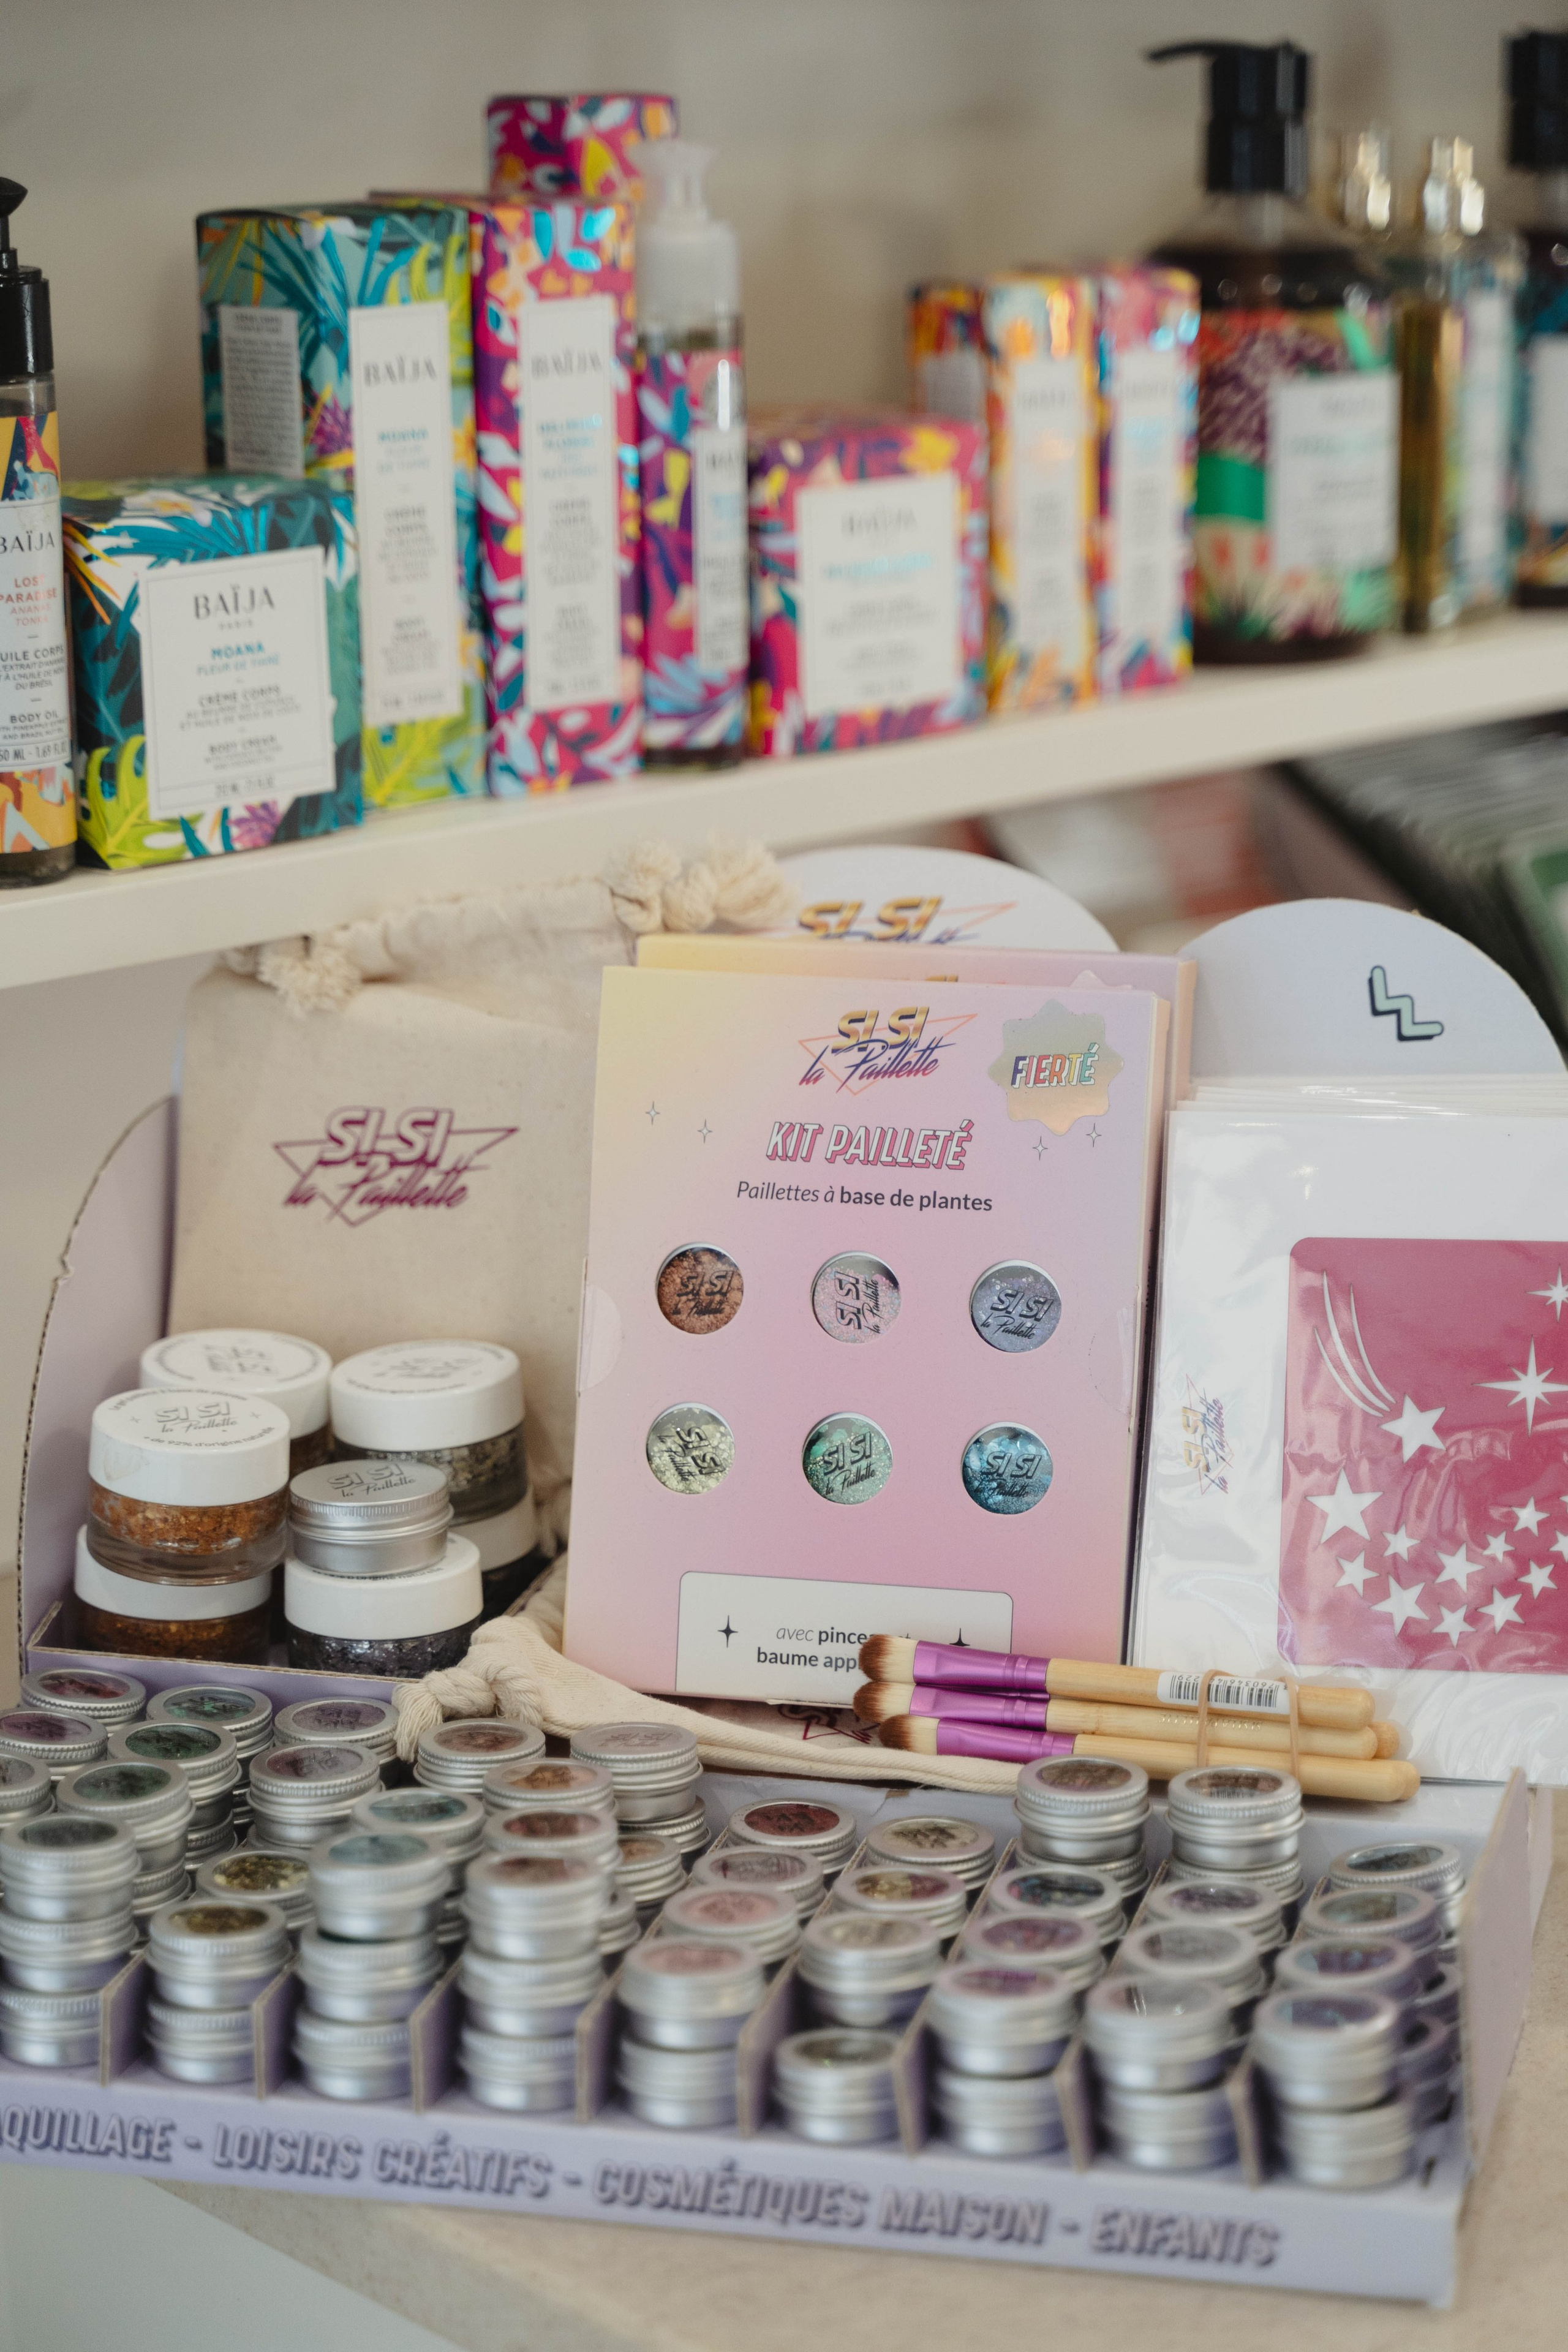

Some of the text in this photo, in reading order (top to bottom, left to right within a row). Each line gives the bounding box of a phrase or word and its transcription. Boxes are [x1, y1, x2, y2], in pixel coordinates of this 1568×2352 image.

[194, 583, 274, 620] BAÏJA
[34, 644, 64, 660] CORPS
[211, 641, 265, 660] MOANA
[0, 662, 37, 673] 'EXTRAIT
[15, 682, 28, 691] DU
[10, 709, 59, 725] BODY OIL
[13, 747, 26, 761] ML
[831, 1006, 930, 1054] SI SI
[799, 1035, 957, 1095] la Paillette
[1011, 1042, 1101, 1089] FIERTÉ
[766, 1118, 974, 1171] KIT PAILLETÉ
[737, 1181, 993, 1212] Paillettes à base de plantes
[705, 1269, 734, 1297] SI
[834, 1270, 862, 1330] SI SI
[861, 1276, 884, 1324] Paillette
[990, 1288, 1054, 1322] SI SI
[980, 1311, 1041, 1340] la Paillette
[155, 1401, 231, 1423] SI SI
[162, 1416, 239, 1434] la Paillette
[195, 1438, 242, 1447] d'origine
[1182, 1406, 1210, 1473] SI SI
[1200, 1387, 1234, 1471] Paillette
[675, 1426, 726, 1475] SI SI
[823, 1430, 872, 1476] SI SI
[981, 1450, 1042, 1479] SI SI
[327, 1463, 404, 1490] SI SI
[341, 1476, 417, 1498] la Paillette
[832, 1461, 876, 1495] Paillette
[776, 1626, 876, 1646] avec pince
[756, 1647, 862, 1673] baume app
[1177, 1673, 1224, 1685] 44229
[1229, 1678, 1275, 1689] 760346
[213, 2121, 363, 2180] LOISIRS
[373, 2130, 555, 2200] CRÉATIFS
[592, 2155, 869, 2228] COSMÉTIQUES
[878, 2183, 1050, 2247] MAISON
[1091, 2209, 1281, 2269] ENFANTS
